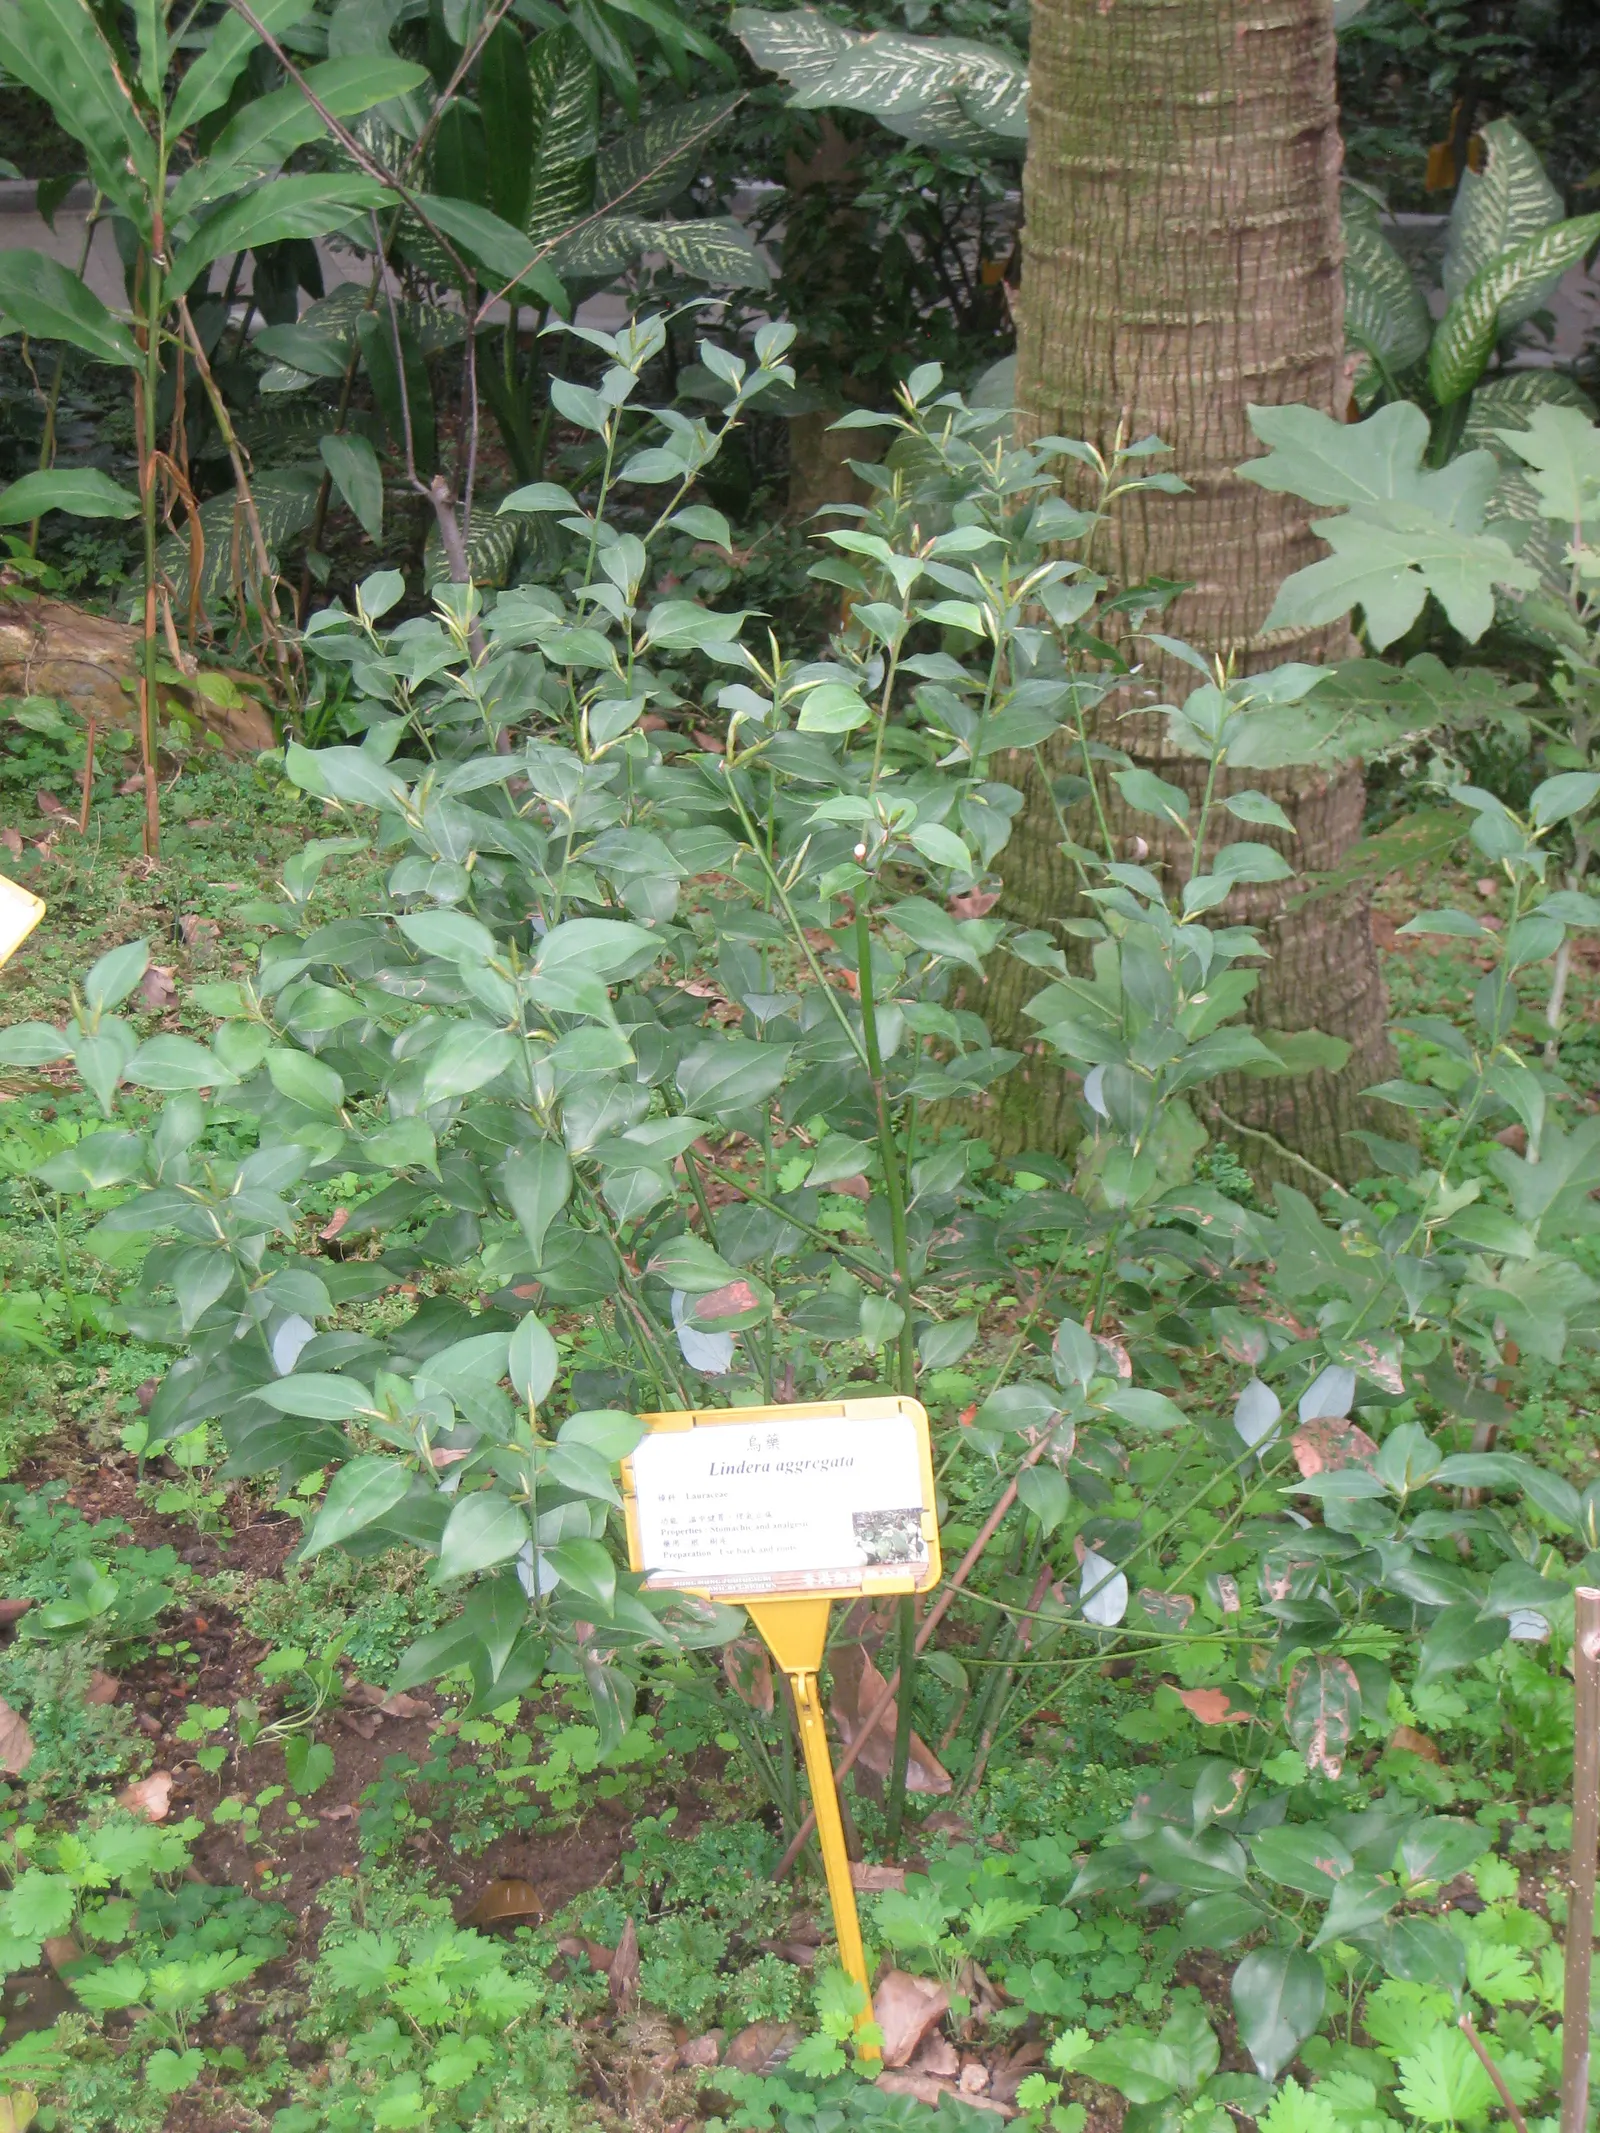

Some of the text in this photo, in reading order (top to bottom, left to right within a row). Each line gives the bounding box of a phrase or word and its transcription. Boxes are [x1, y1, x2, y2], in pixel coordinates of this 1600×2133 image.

[747, 1432, 780, 1452] 烏藥
[709, 1456, 855, 1477] Lindera aggregata
[686, 1492, 728, 1501] Lauraceae
[660, 1527, 703, 1537] Properties
[710, 1524, 753, 1533] Stomachic
[755, 1522, 770, 1531] and
[663, 1549, 712, 1560] Preparation
[736, 1545, 755, 1555] bark
[758, 1544, 773, 1554] and
